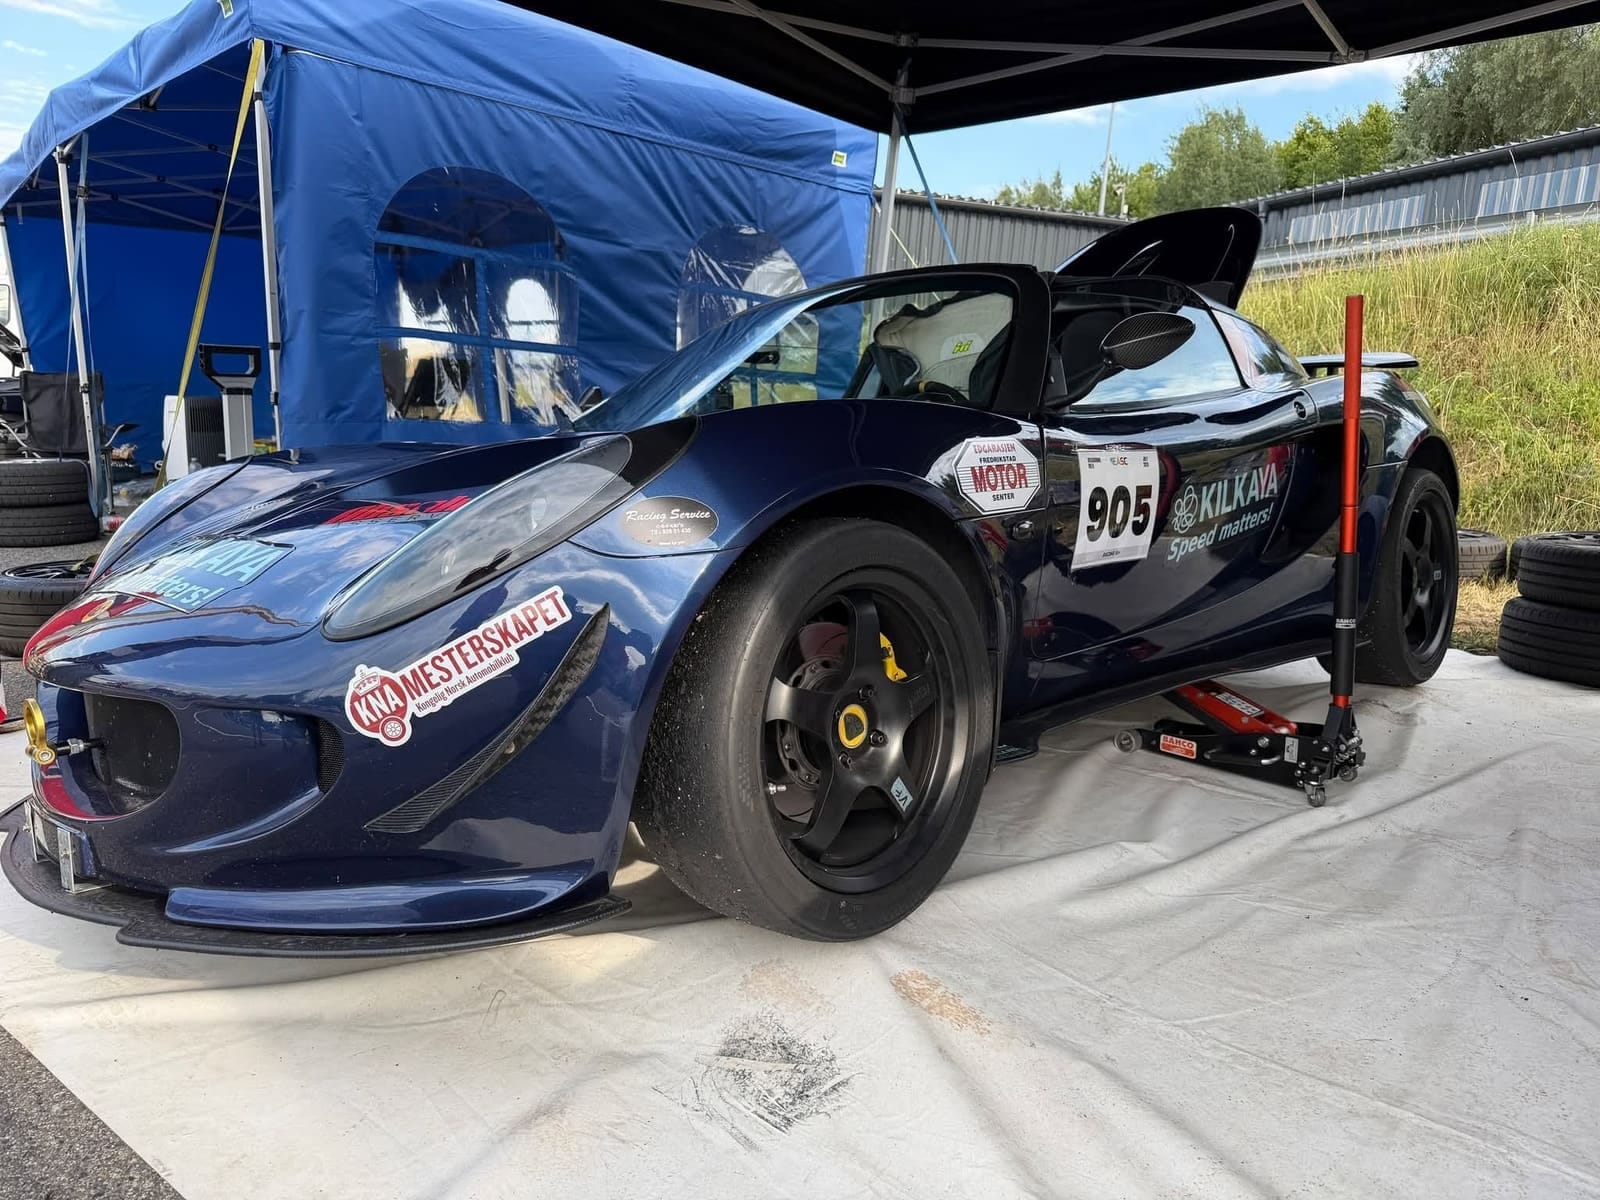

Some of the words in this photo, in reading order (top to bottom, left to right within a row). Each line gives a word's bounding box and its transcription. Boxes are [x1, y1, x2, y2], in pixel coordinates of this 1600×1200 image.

[979, 455, 1017, 464] FREDRIKSTAD
[970, 462, 1029, 493] MOTOR
[1199, 462, 1278, 522] KILKAYA
[991, 492, 1015, 502] SENTER
[1086, 484, 1153, 542] 905
[625, 509, 667, 523] Racing
[669, 508, 711, 520] Service
[1167, 523, 1218, 562] Speed
[1218, 501, 1274, 541] matters!
[354, 682, 405, 727] KNA
[399, 591, 567, 701] MESTERSKAPET
[415, 690, 449, 713] Kongelig
[447, 678, 468, 698] Norsk
[1161, 735, 1195, 750] BAHCO
